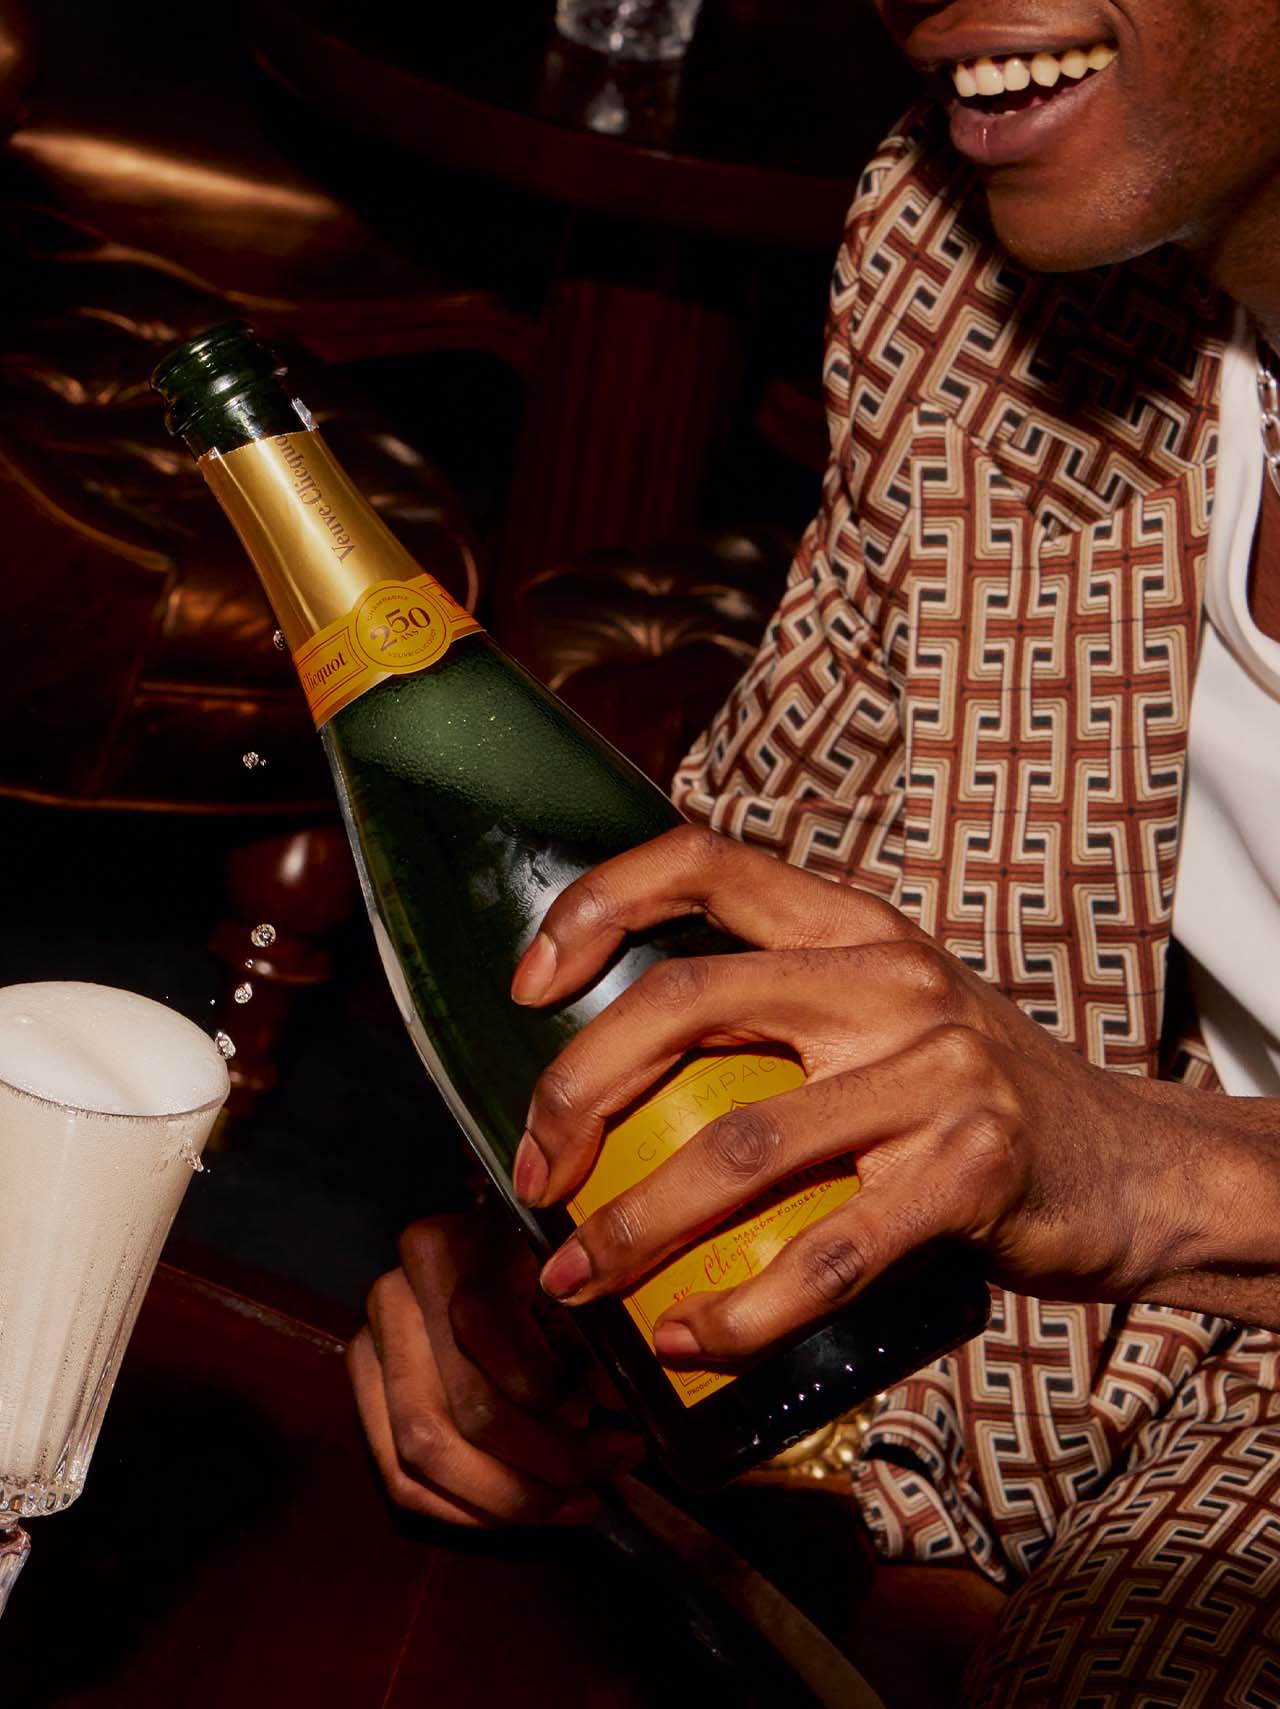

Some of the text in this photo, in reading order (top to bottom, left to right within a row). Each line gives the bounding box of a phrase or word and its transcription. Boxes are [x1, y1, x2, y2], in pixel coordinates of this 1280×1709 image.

[274, 435, 356, 566] Veuve Clicquo
[369, 606, 432, 653] 250
[637, 1056, 783, 1163] CHAMPAG
